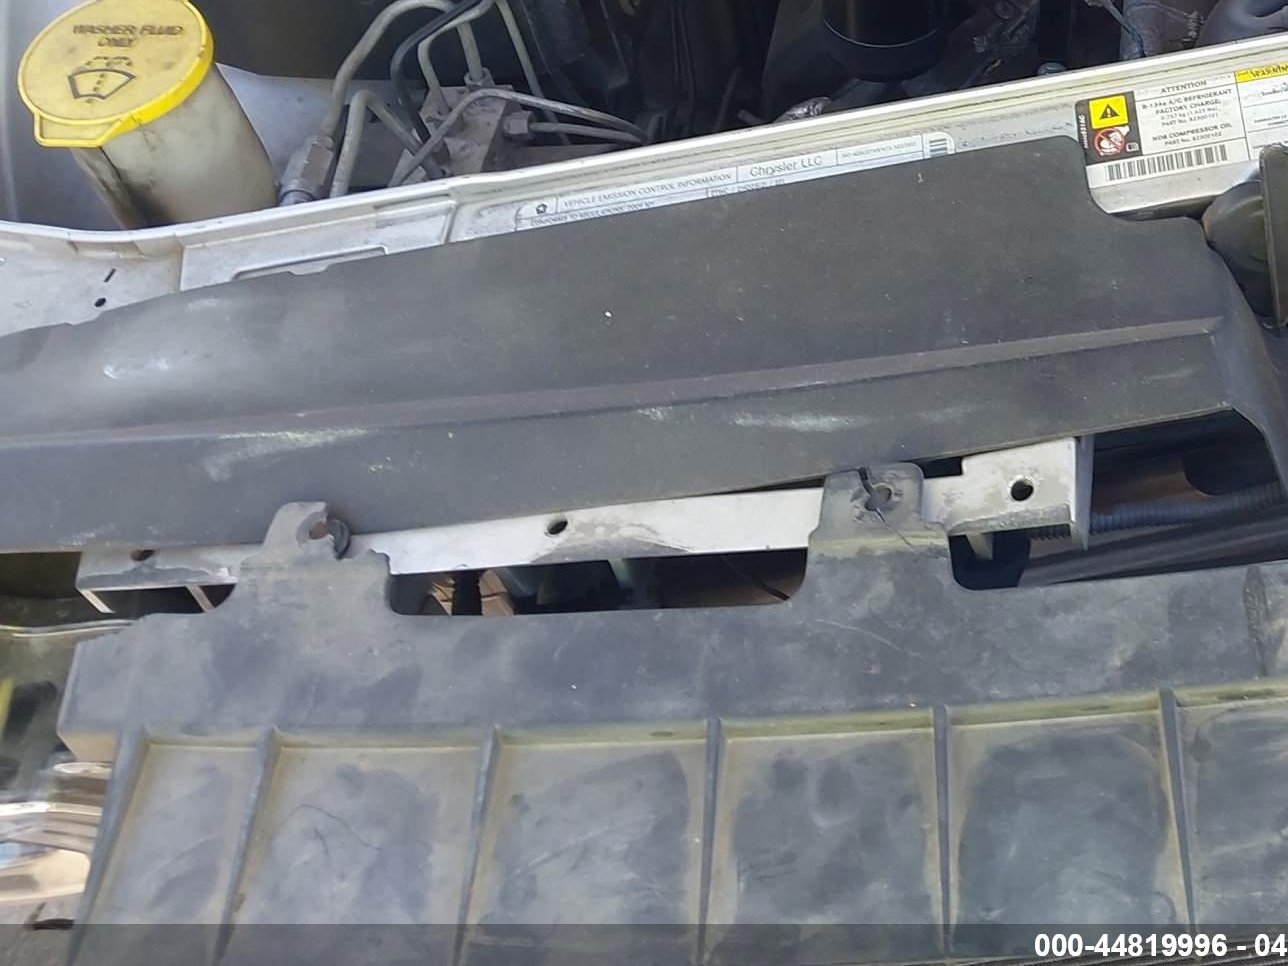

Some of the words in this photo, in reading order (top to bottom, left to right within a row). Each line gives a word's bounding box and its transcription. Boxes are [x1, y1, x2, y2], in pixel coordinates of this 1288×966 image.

[73, 24, 136, 35] WASHER
[140, 24, 184, 35] FLUID
[98, 37, 134, 47] ONLY
[1160, 79, 1207, 94] ATTENTION
[1141, 100, 1166, 109] R-134a
[1168, 97, 1182, 105] A/C
[1183, 87, 1232, 102] REFRIGERANT
[1155, 103, 1187, 115] FACTORY
[1168, 123, 1218, 139] COMPRESSOR
[1220, 121, 1232, 129] OIL
[1164, 138, 1179, 146] PART
[750, 159, 797, 178] Chrysler
[801, 155, 822, 168] LLC
[563, 195, 594, 208] VEHICLE
[638, 182, 675, 195] CONTROL
[678, 172, 730, 188] INFORMATION
